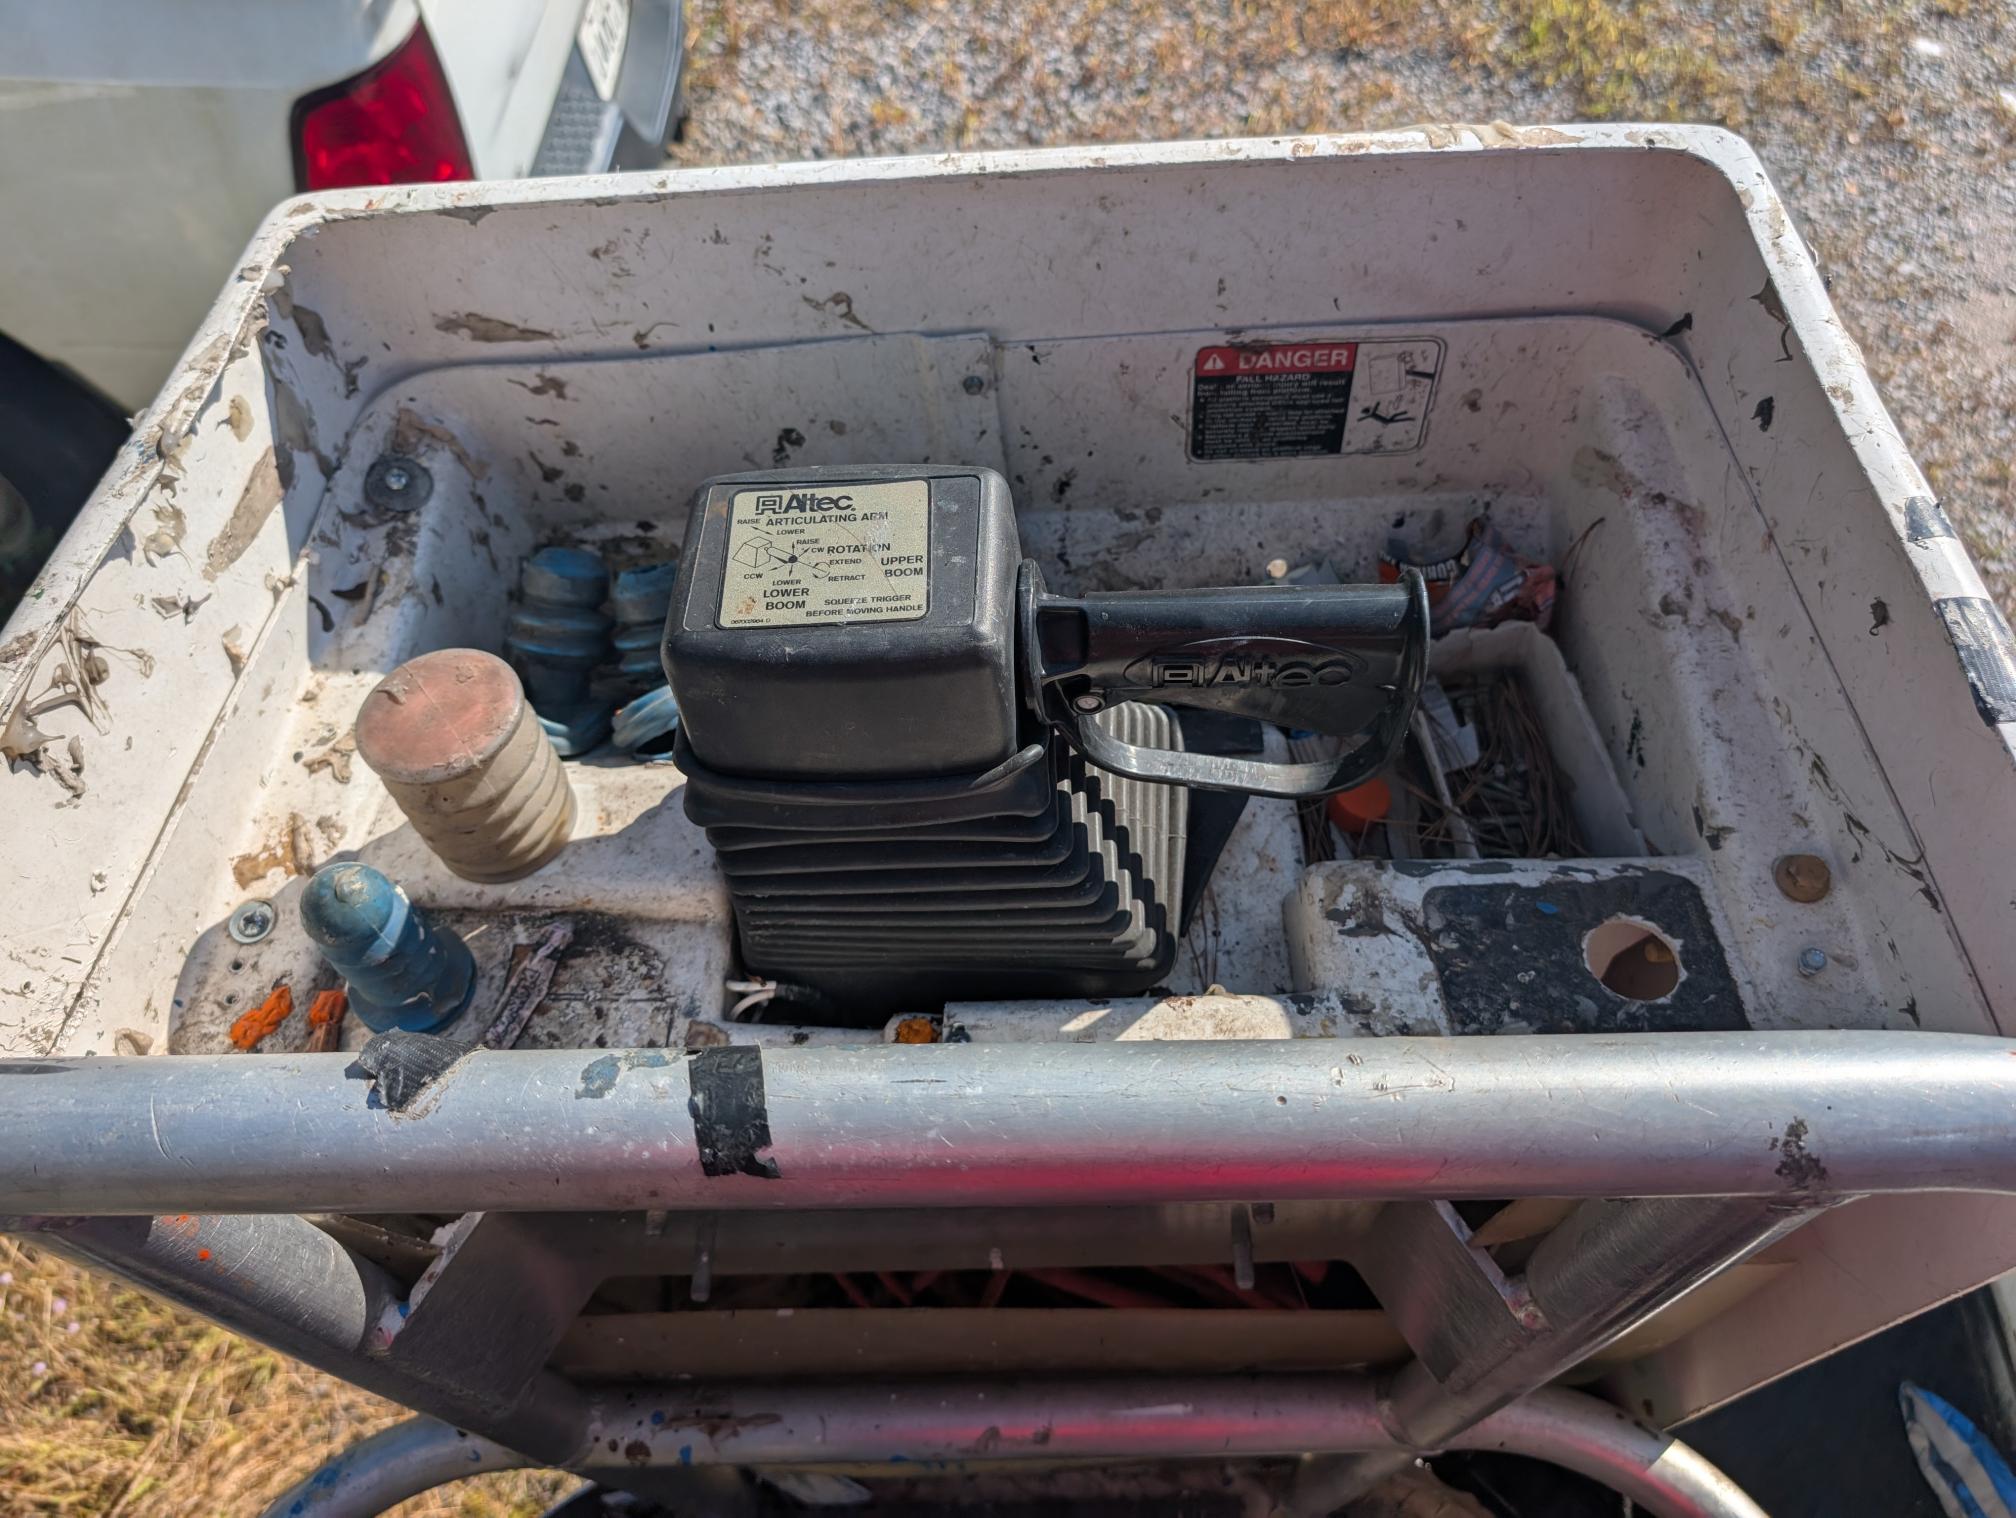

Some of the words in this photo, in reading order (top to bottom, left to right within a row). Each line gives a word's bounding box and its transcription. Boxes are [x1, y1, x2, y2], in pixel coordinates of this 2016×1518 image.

[1238, 349, 1349, 369] DANGER
[1235, 374, 1263, 383] FALL
[1265, 372, 1311, 382] HAZARD
[783, 493, 854, 513] Altec
[766, 514, 857, 527] ARTICULATING
[776, 528, 806, 536] LOWER
[881, 555, 924, 566] UPPER
[828, 574, 866, 582] RETRACT
[884, 567, 924, 578] BOOM
[763, 588, 809, 599] LOWER
[766, 600, 806, 610] BOOM
[824, 597, 868, 606] SQUEEZE
[870, 594, 912, 603] TRIGGER
[805, 608, 844, 617] BEFORE
[847, 606, 883, 615] MOVING
[887, 604, 924, 613] HANDLE
[1206, 654, 1352, 688] Altec
